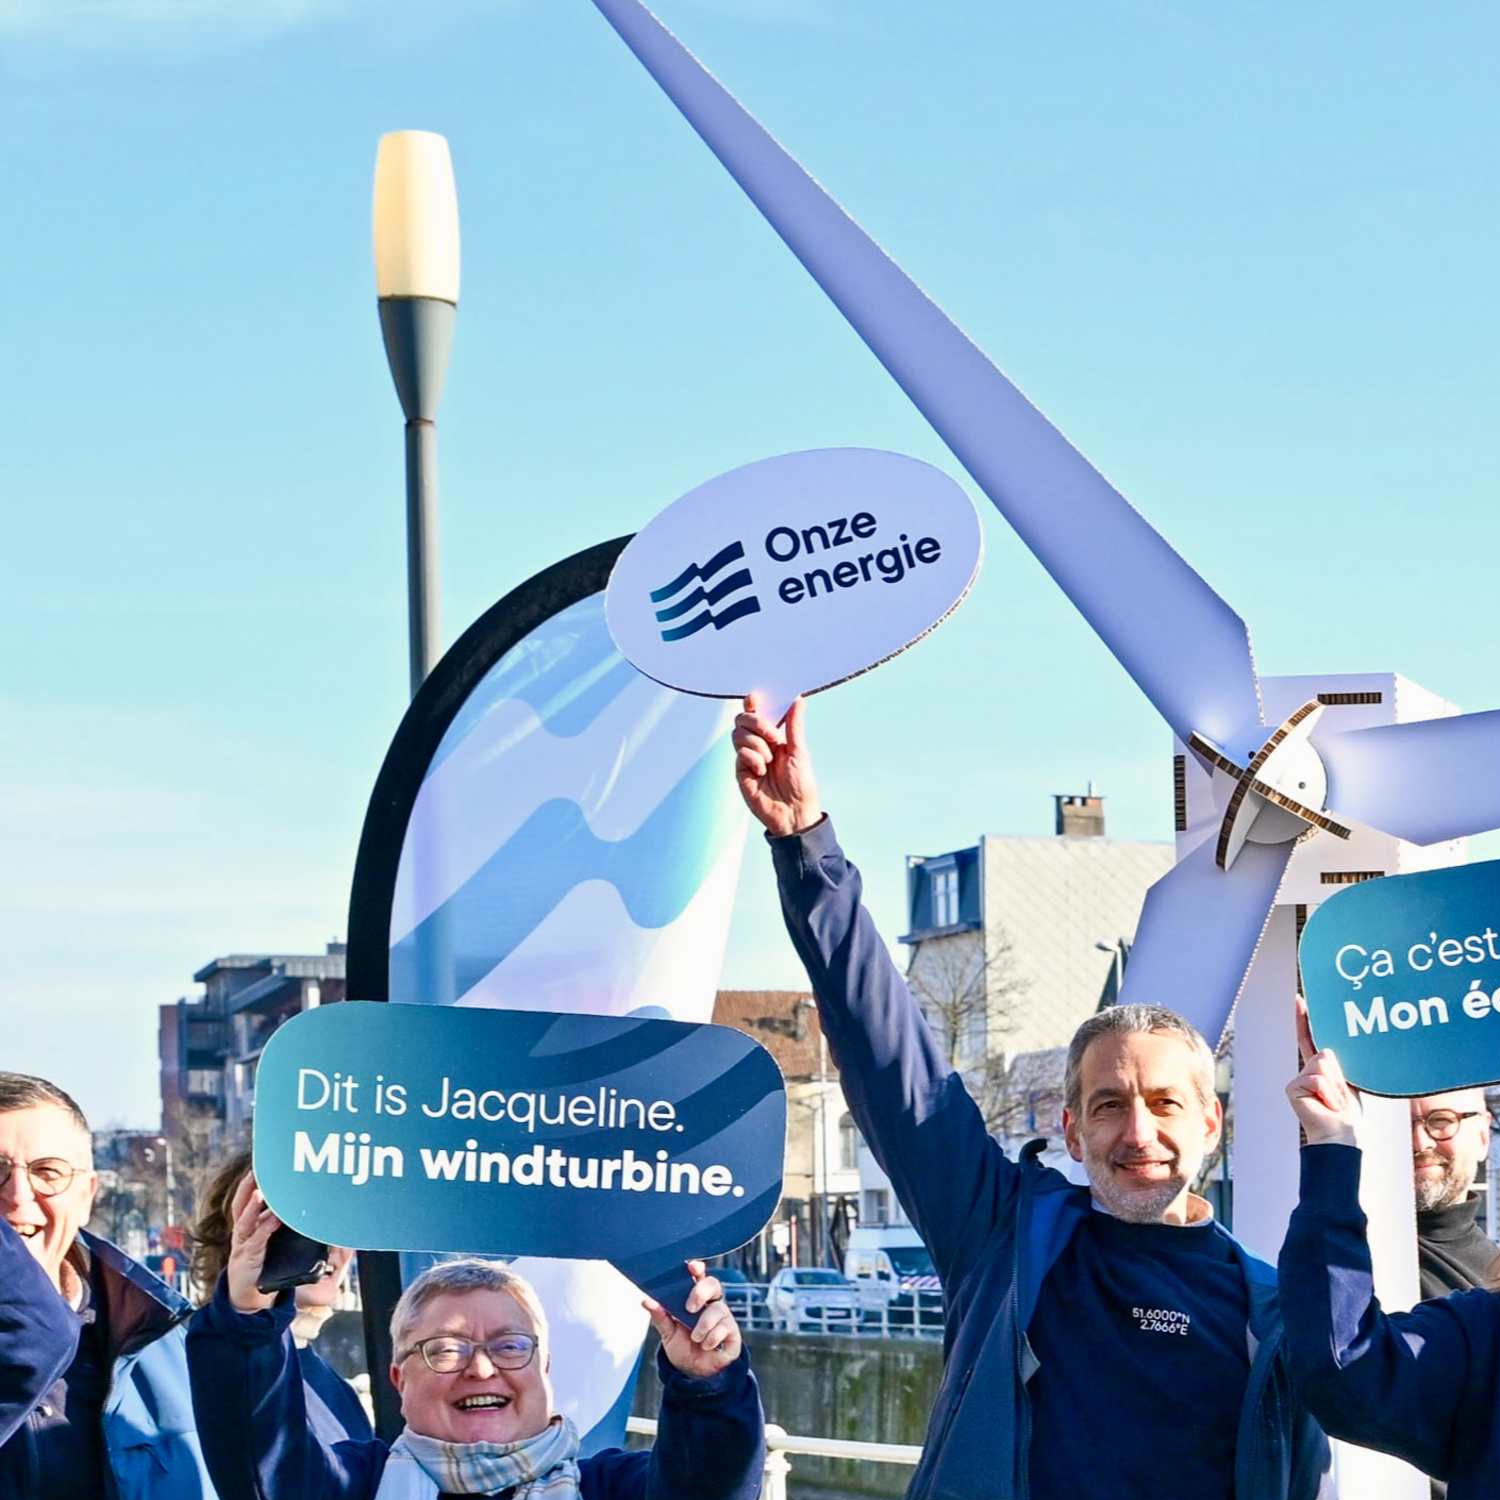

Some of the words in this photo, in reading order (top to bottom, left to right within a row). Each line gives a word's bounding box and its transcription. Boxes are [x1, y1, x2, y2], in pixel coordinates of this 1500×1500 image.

[765, 511, 877, 563] Onze
[778, 533, 942, 604] energie
[1335, 943, 1395, 990] Ça
[1344, 995, 1449, 1037] Mon
[297, 1068, 359, 1114] Dit
[375, 1075, 407, 1117] is
[421, 1077, 685, 1133] Jacqueline.
[293, 1131, 403, 1186] Mijn
[421, 1139, 746, 1198] windturbine.
